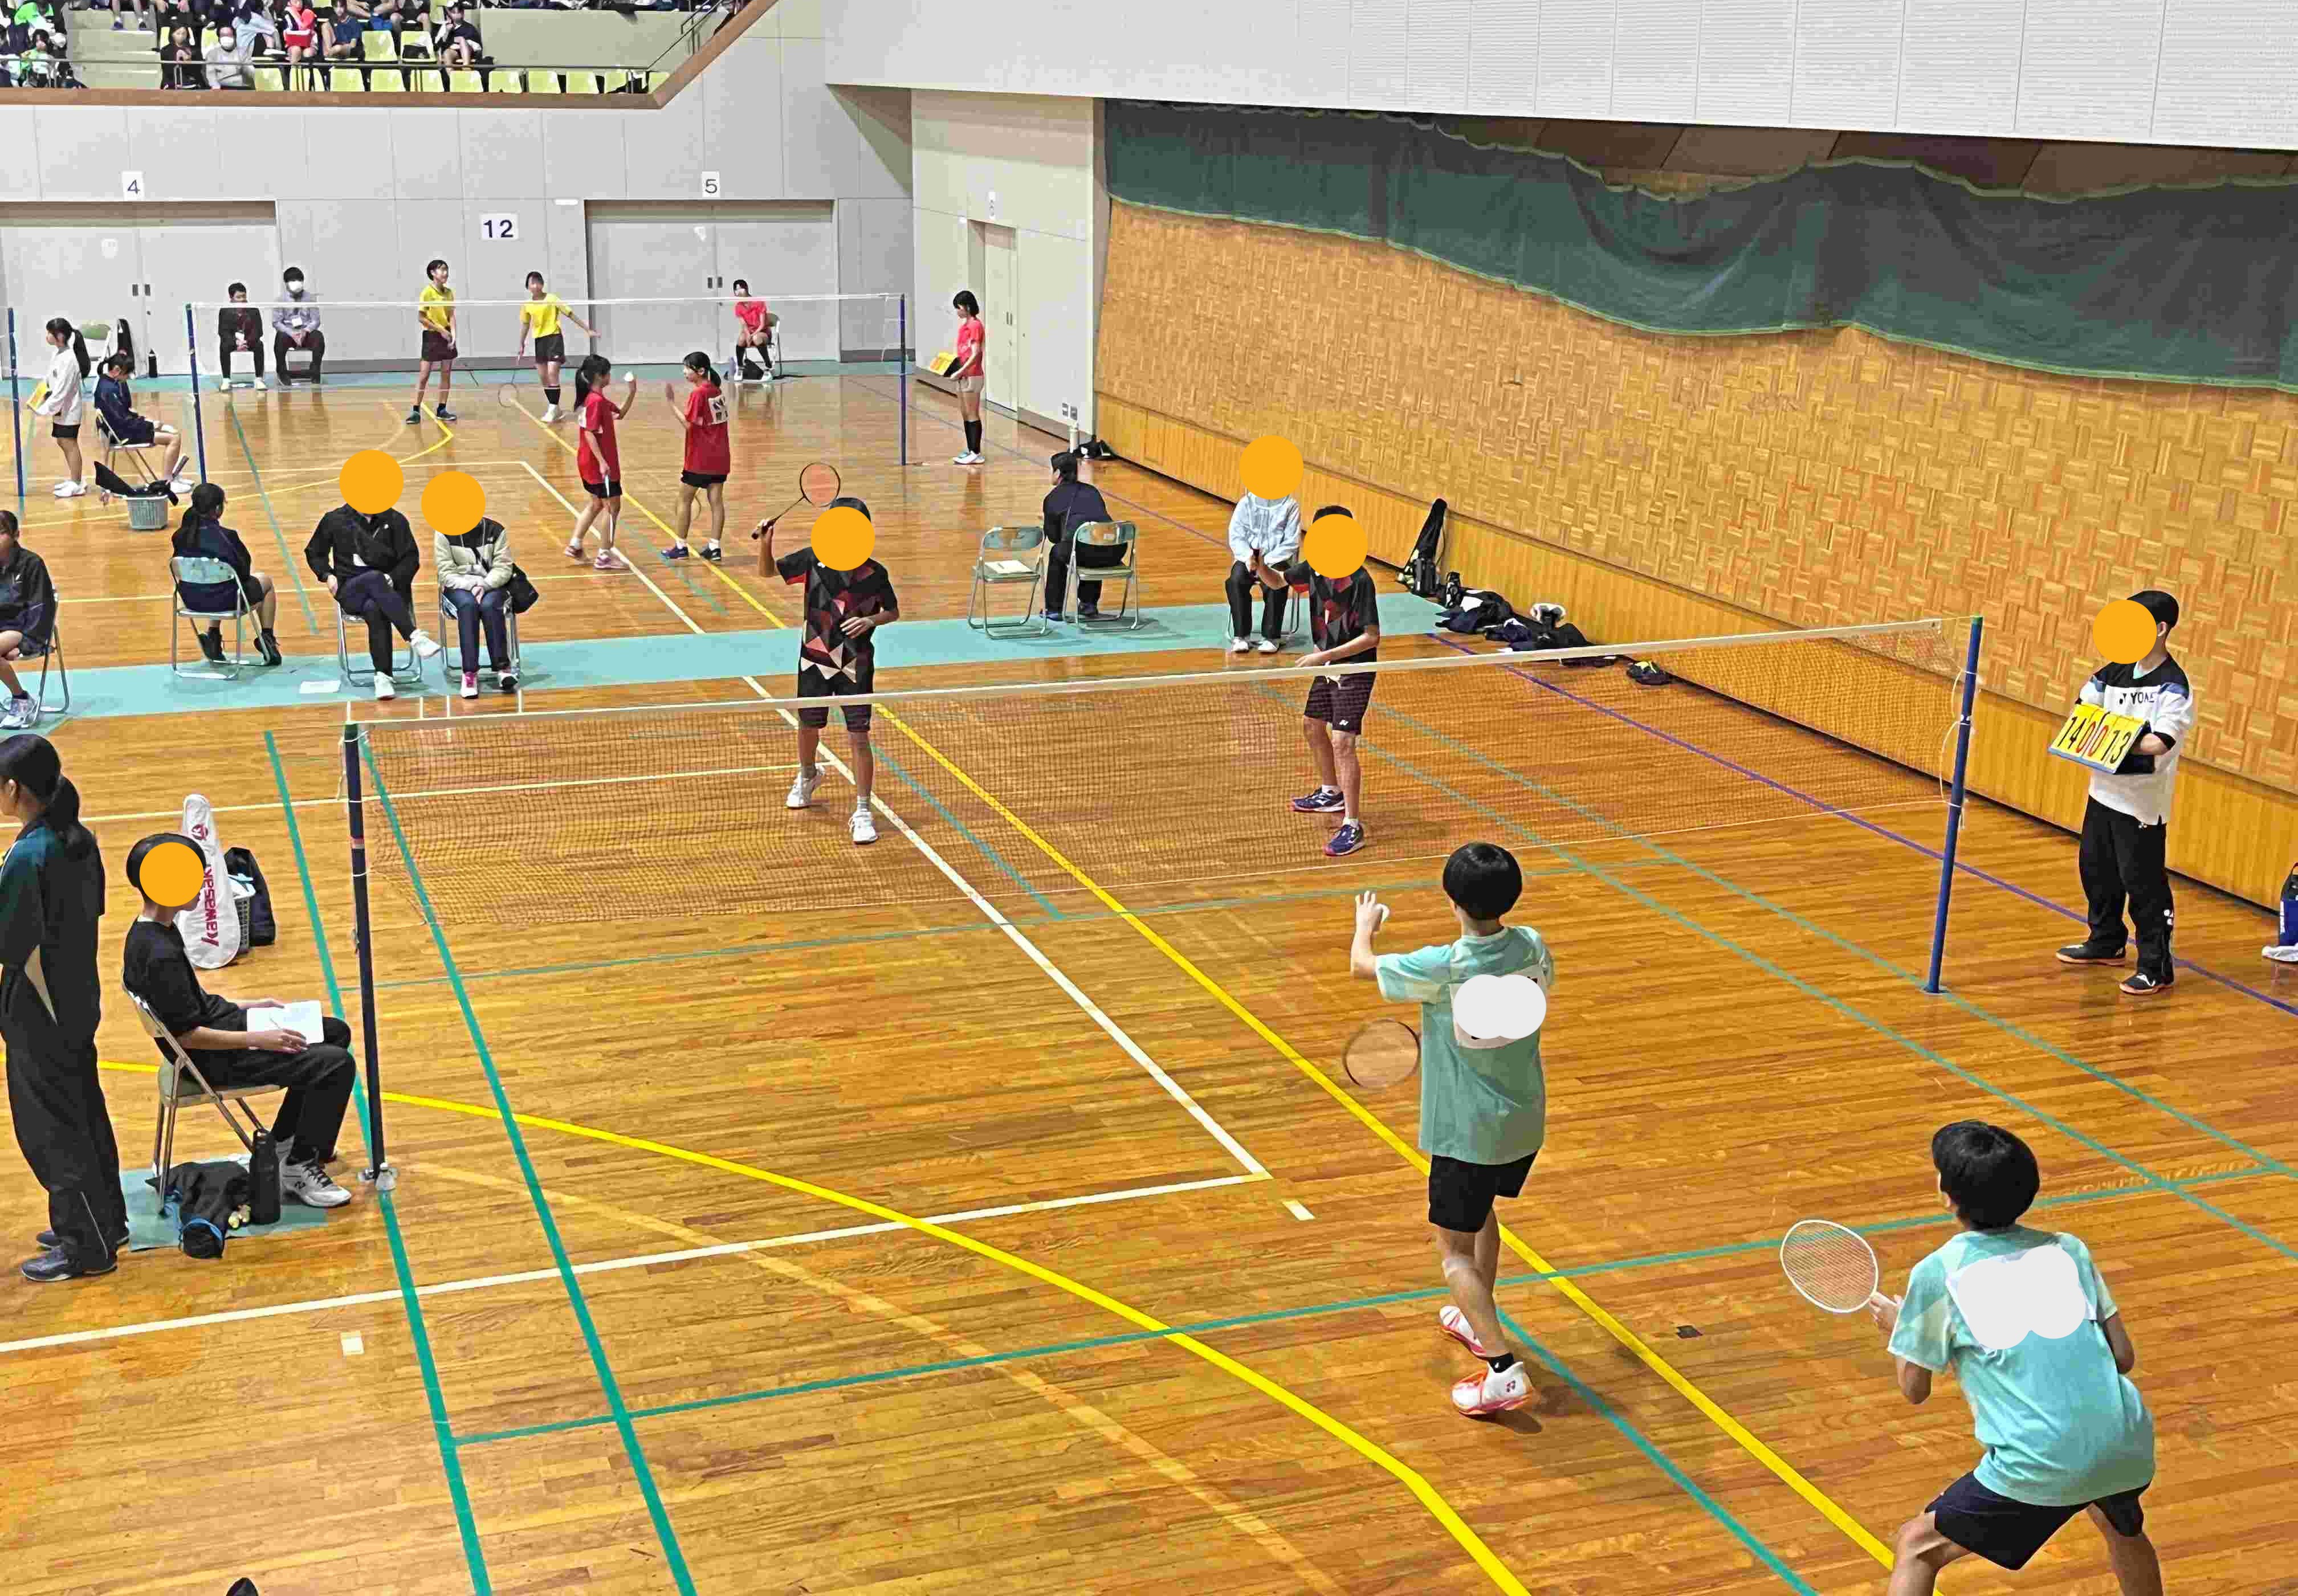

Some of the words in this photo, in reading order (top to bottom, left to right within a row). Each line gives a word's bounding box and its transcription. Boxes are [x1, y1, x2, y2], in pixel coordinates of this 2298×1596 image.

[128, 179, 140, 194] 4
[705, 179, 717, 194] 5
[483, 219, 514, 238] 12
